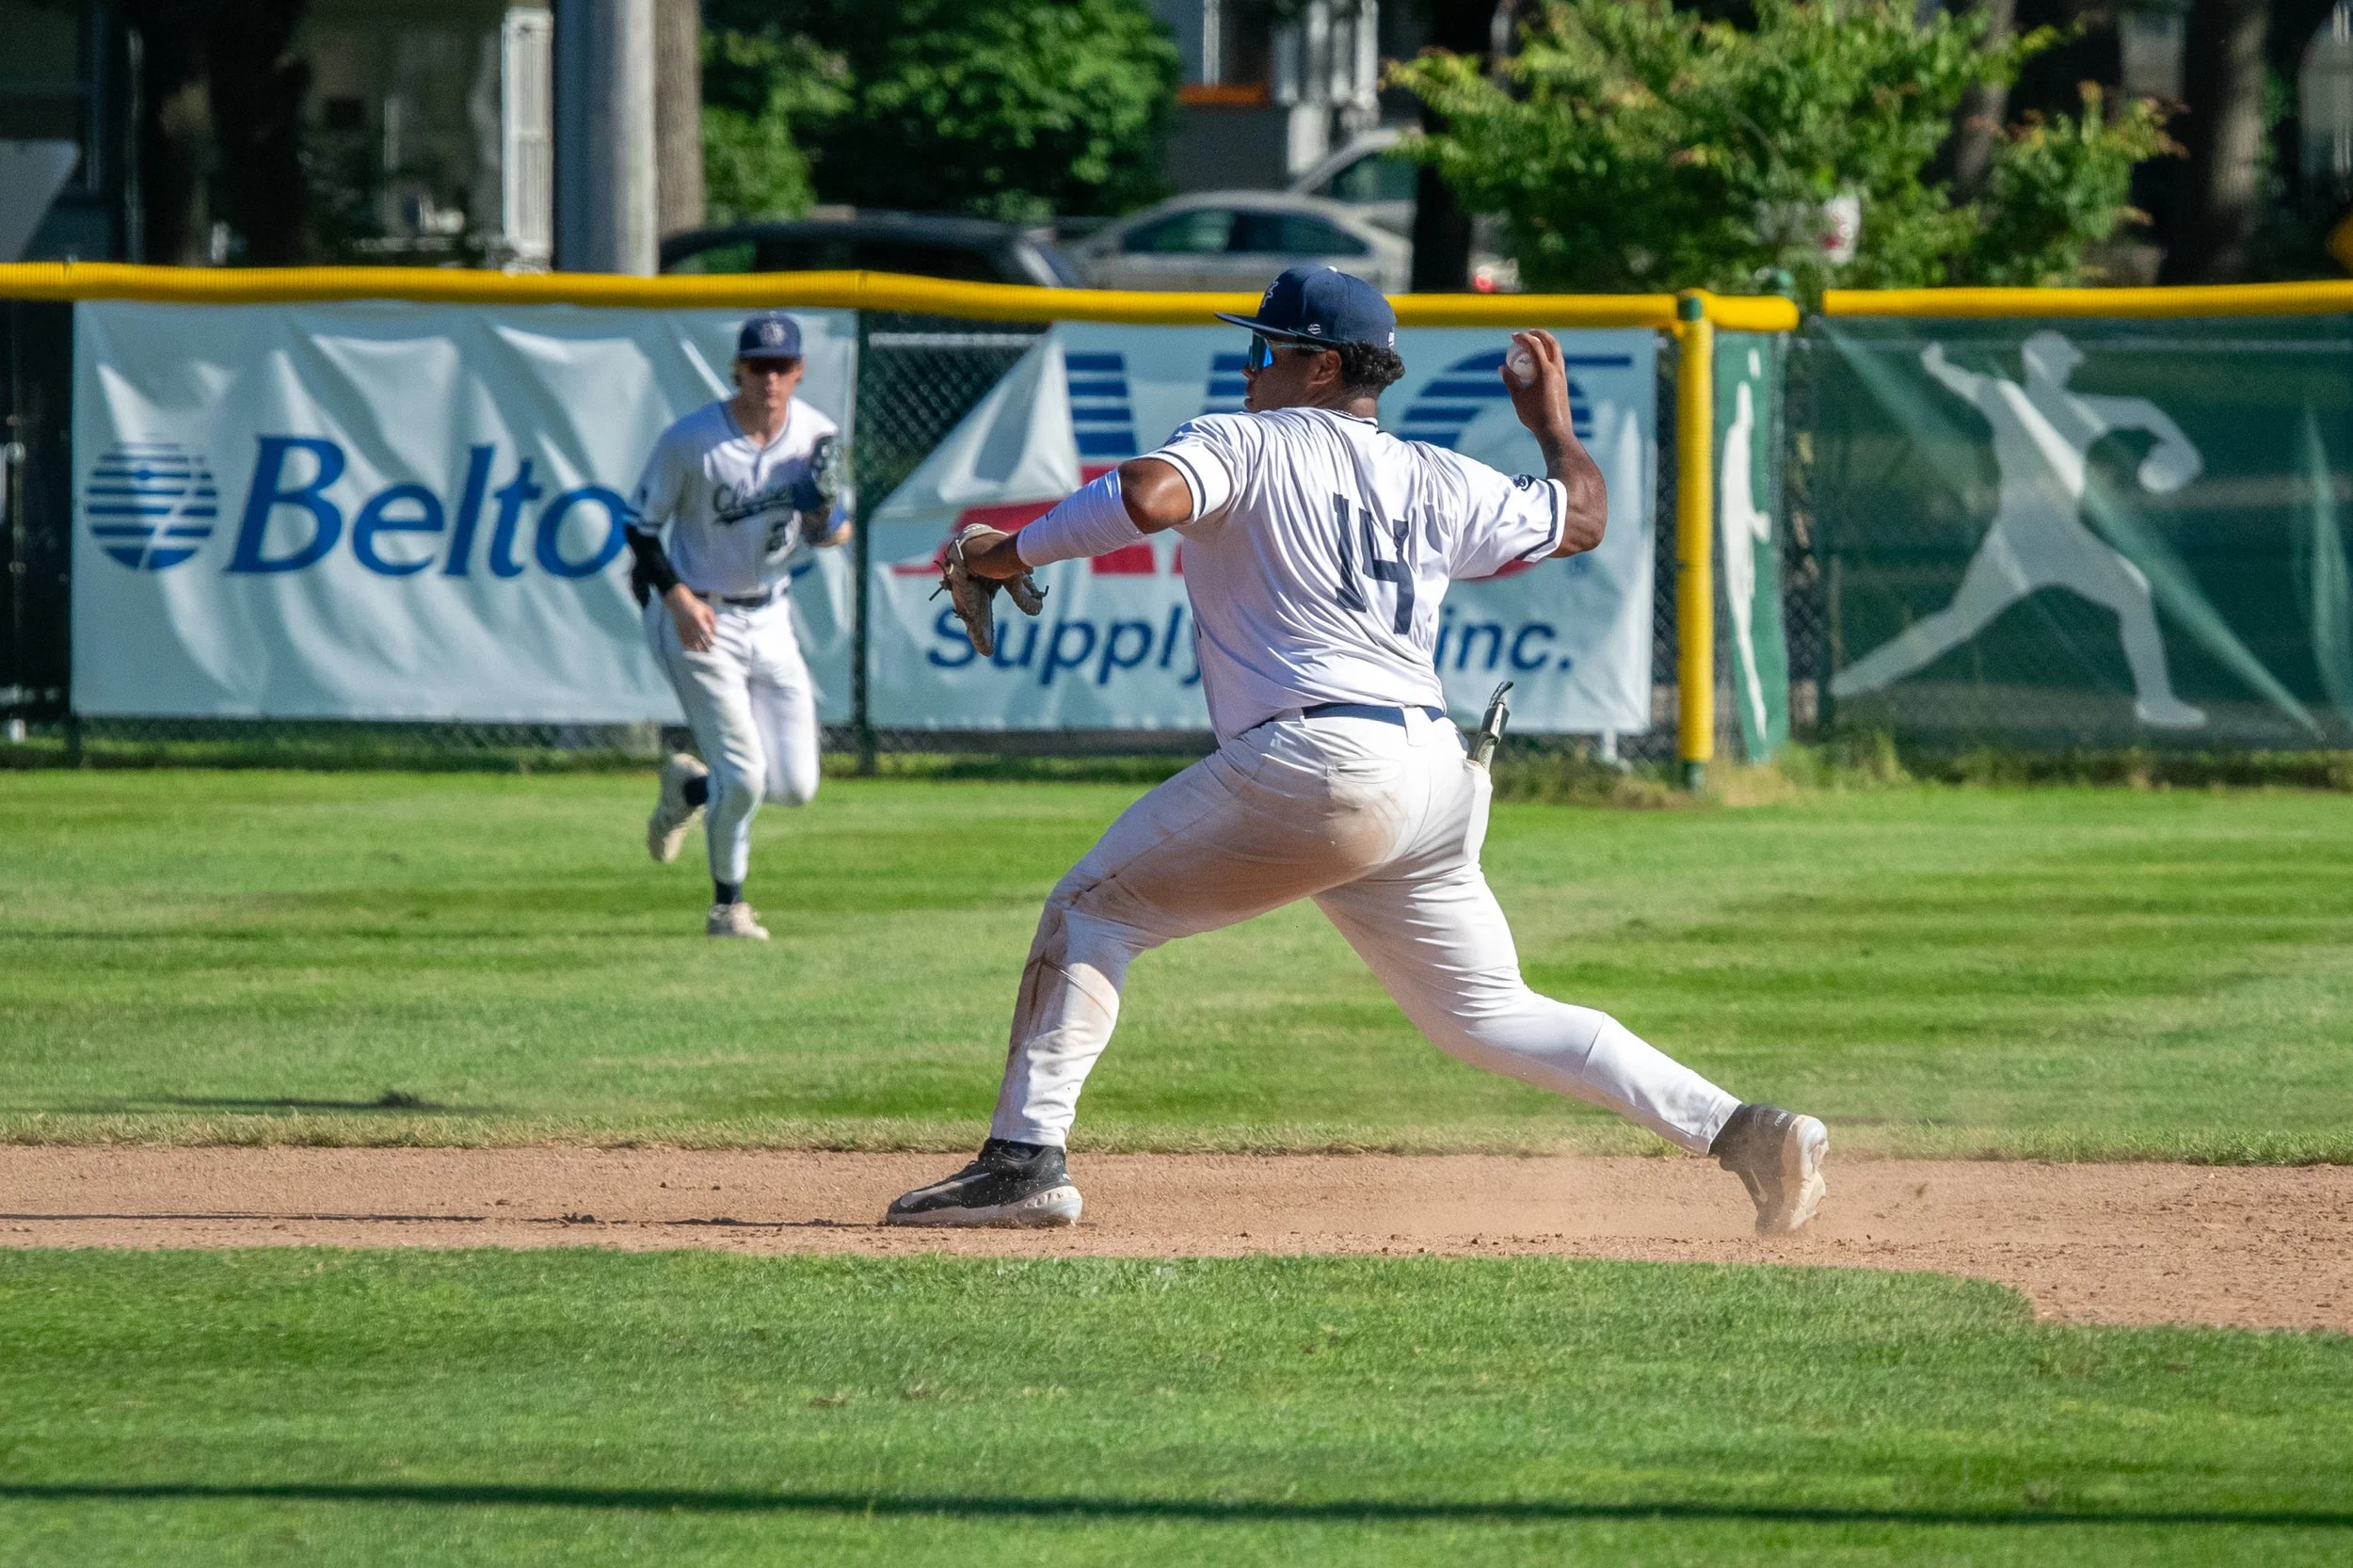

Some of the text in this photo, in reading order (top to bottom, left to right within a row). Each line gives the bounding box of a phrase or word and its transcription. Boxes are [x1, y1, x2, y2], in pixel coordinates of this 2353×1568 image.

[222, 434, 813, 579] Belto
[1333, 492, 1415, 634] 14
[1434, 606, 1572, 670] inc.
